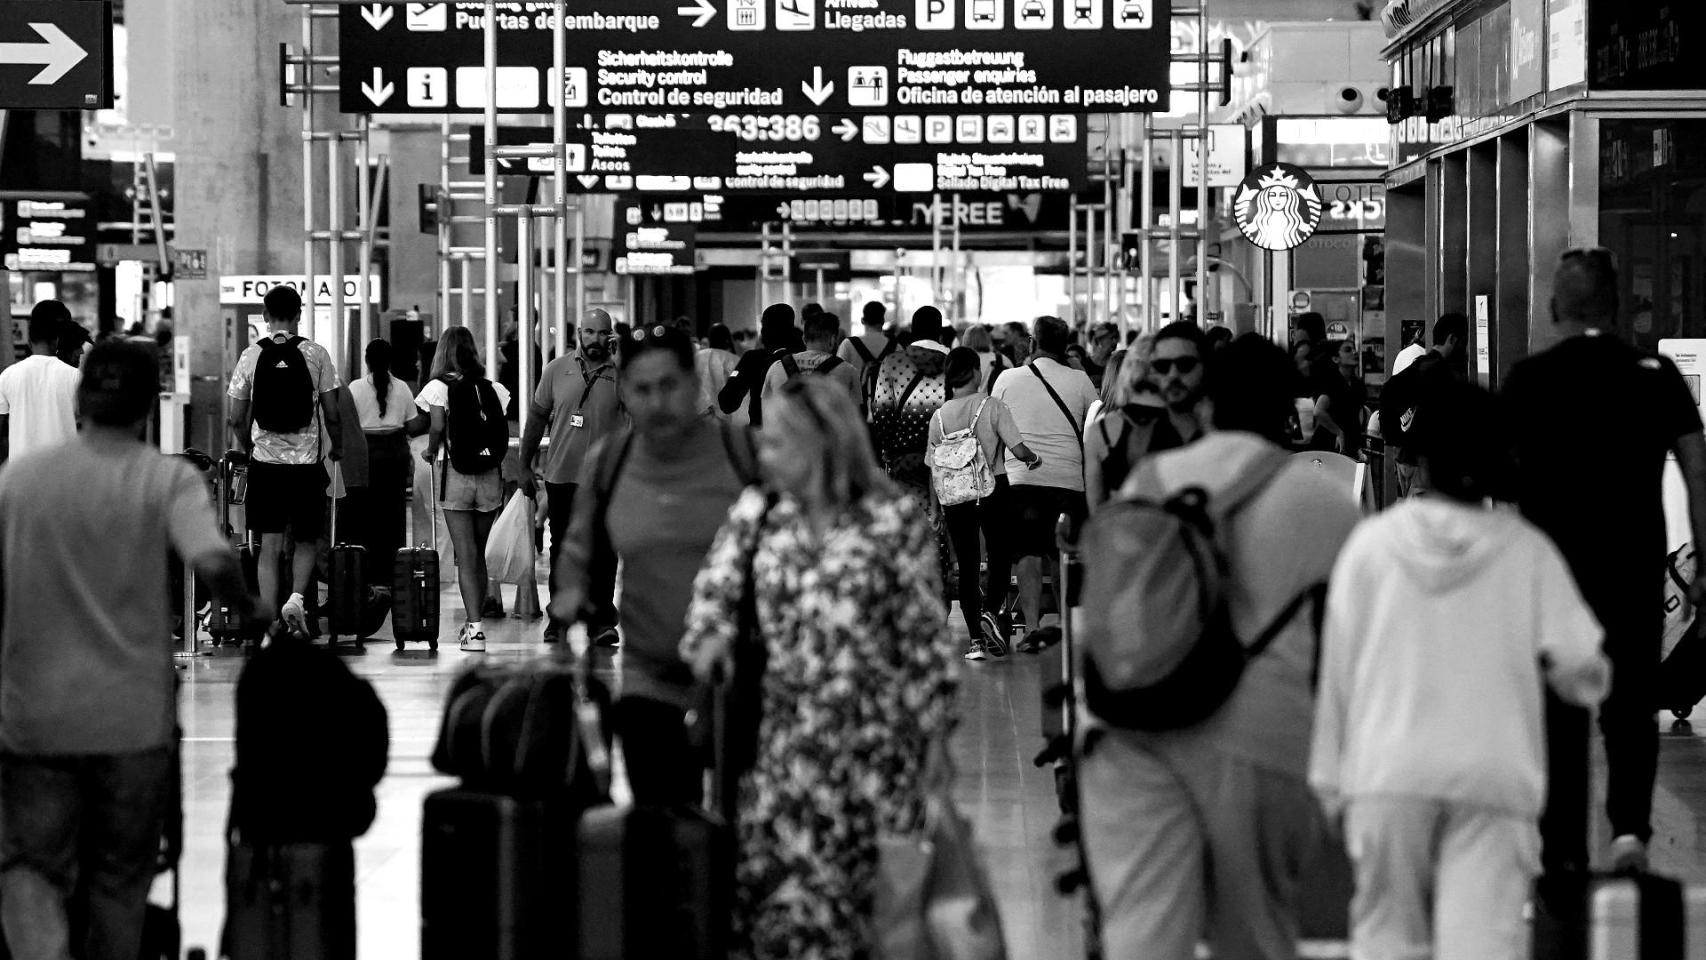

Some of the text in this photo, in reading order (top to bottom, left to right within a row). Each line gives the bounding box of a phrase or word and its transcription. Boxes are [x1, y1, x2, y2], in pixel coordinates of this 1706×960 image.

[455, 11, 530, 30] Putas
[564, 11, 660, 33] embarque
[824, 10, 907, 32] Llegadas
[597, 49, 734, 67] Sicherheitskontrolle
[897, 49, 1024, 68] Fluggastbetreuung
[597, 68, 707, 88] Security control
[897, 66, 1036, 86] Passenger enquiries
[597, 87, 784, 109] Control de seguridad
[896, 85, 1159, 107] Oficina de atención al pasajero
[591, 158, 631, 172] Aseos
[785, 174, 846, 192] seguridad
[980, 175, 1018, 192] Digital
[1018, 175, 1041, 190] Tax
[1041, 175, 1070, 190] Free
